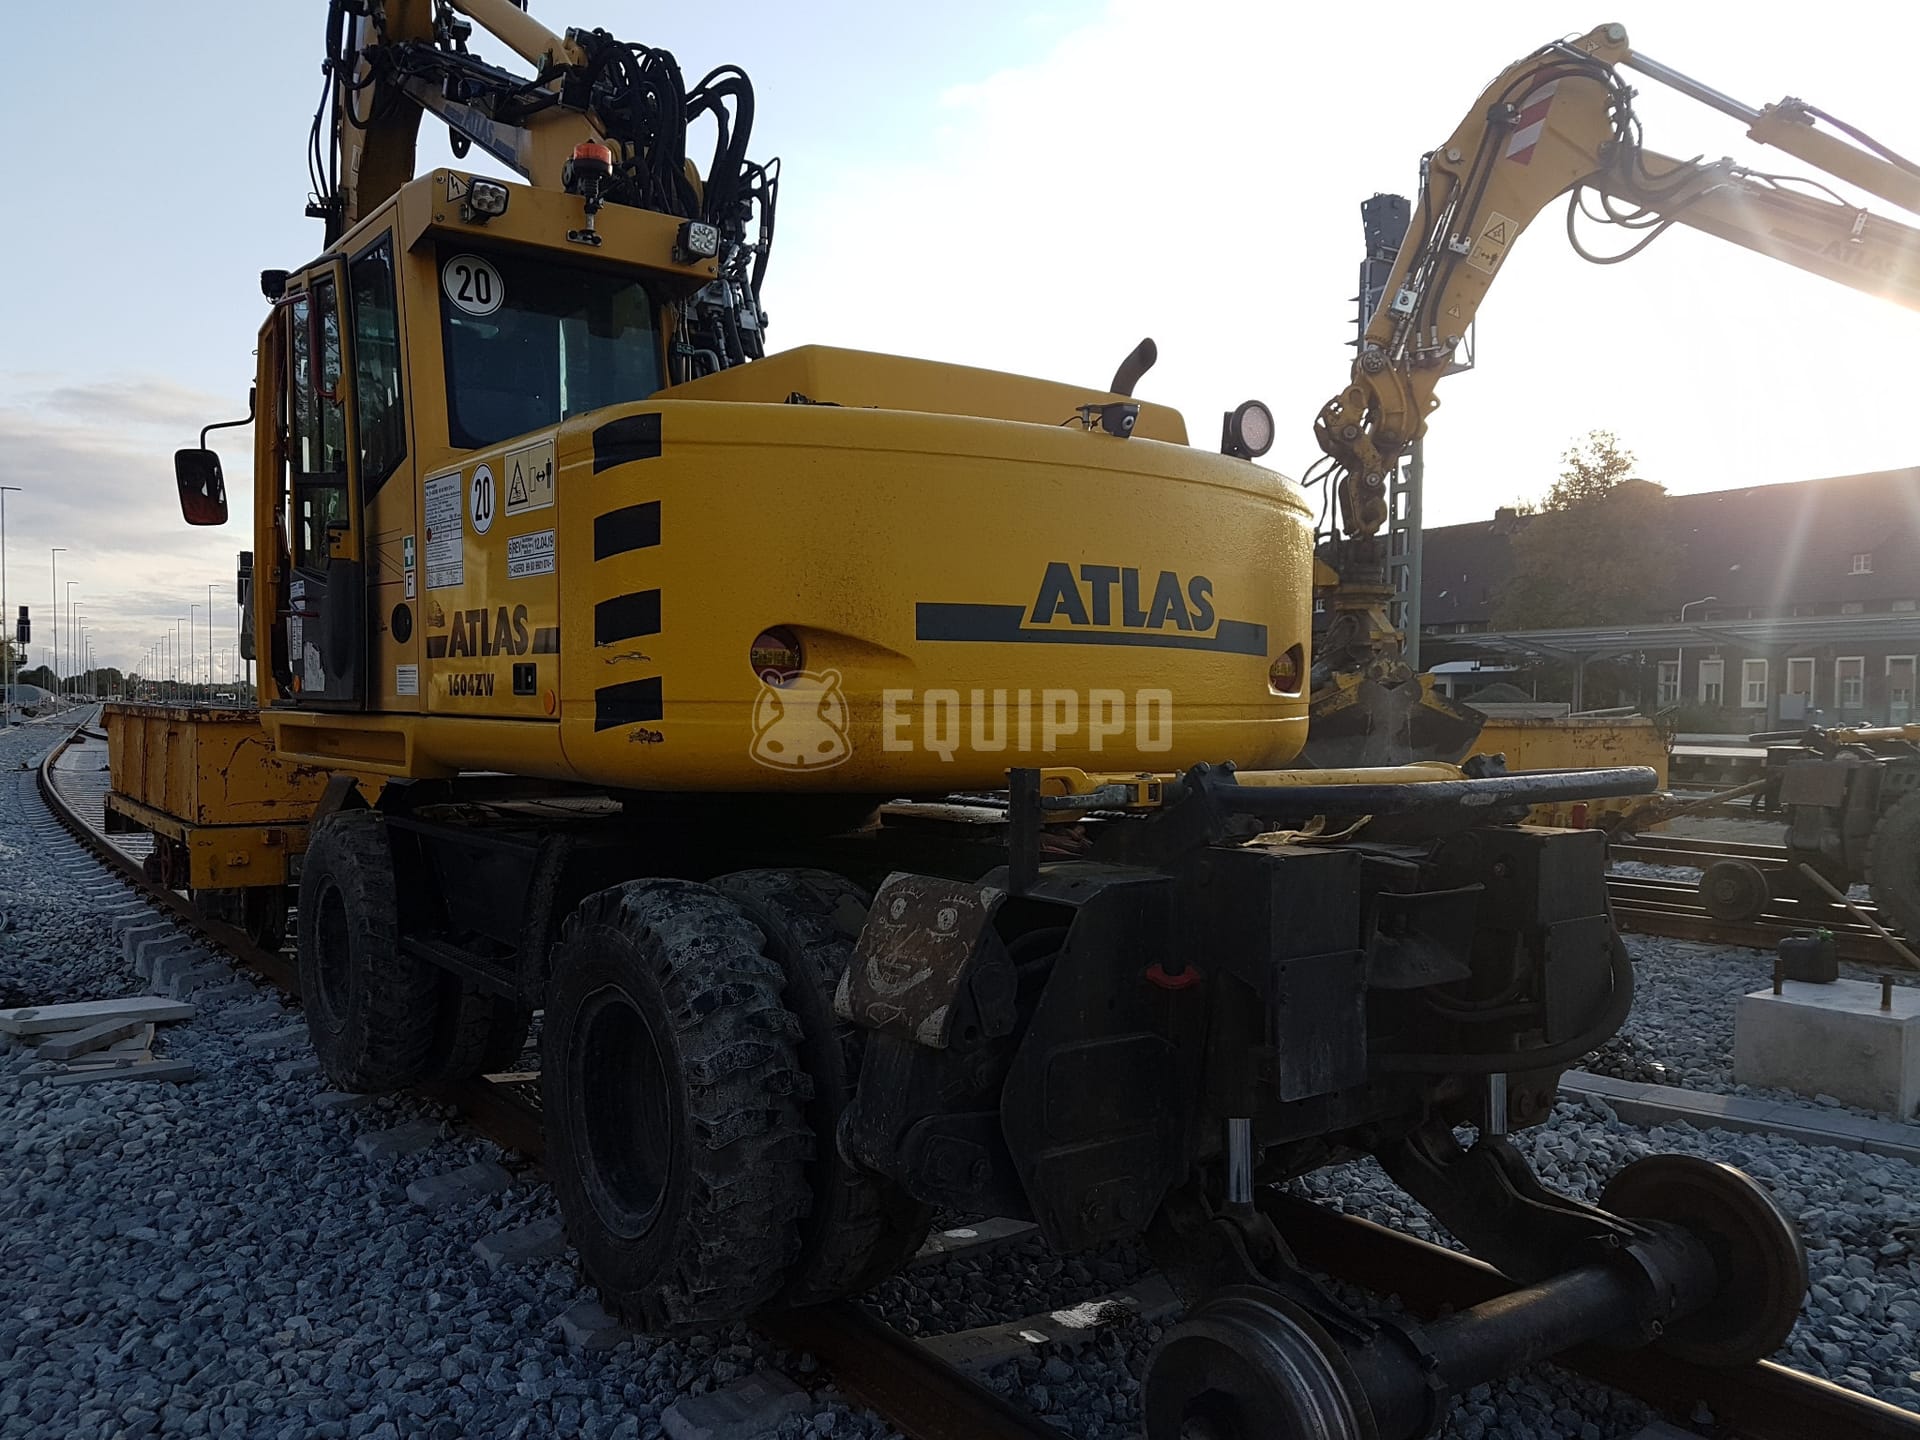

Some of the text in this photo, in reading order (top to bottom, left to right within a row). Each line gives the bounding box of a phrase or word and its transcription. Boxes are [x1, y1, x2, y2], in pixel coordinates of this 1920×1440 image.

[456, 265, 491, 305] 20
[475, 477, 490, 521] 20
[407, 574, 413, 595] F
[1030, 562, 1214, 632] ATLAS
[448, 604, 529, 657] ATLAS
[1640, 653, 1646, 665] 2
[448, 673, 495, 697] 1604ZW
